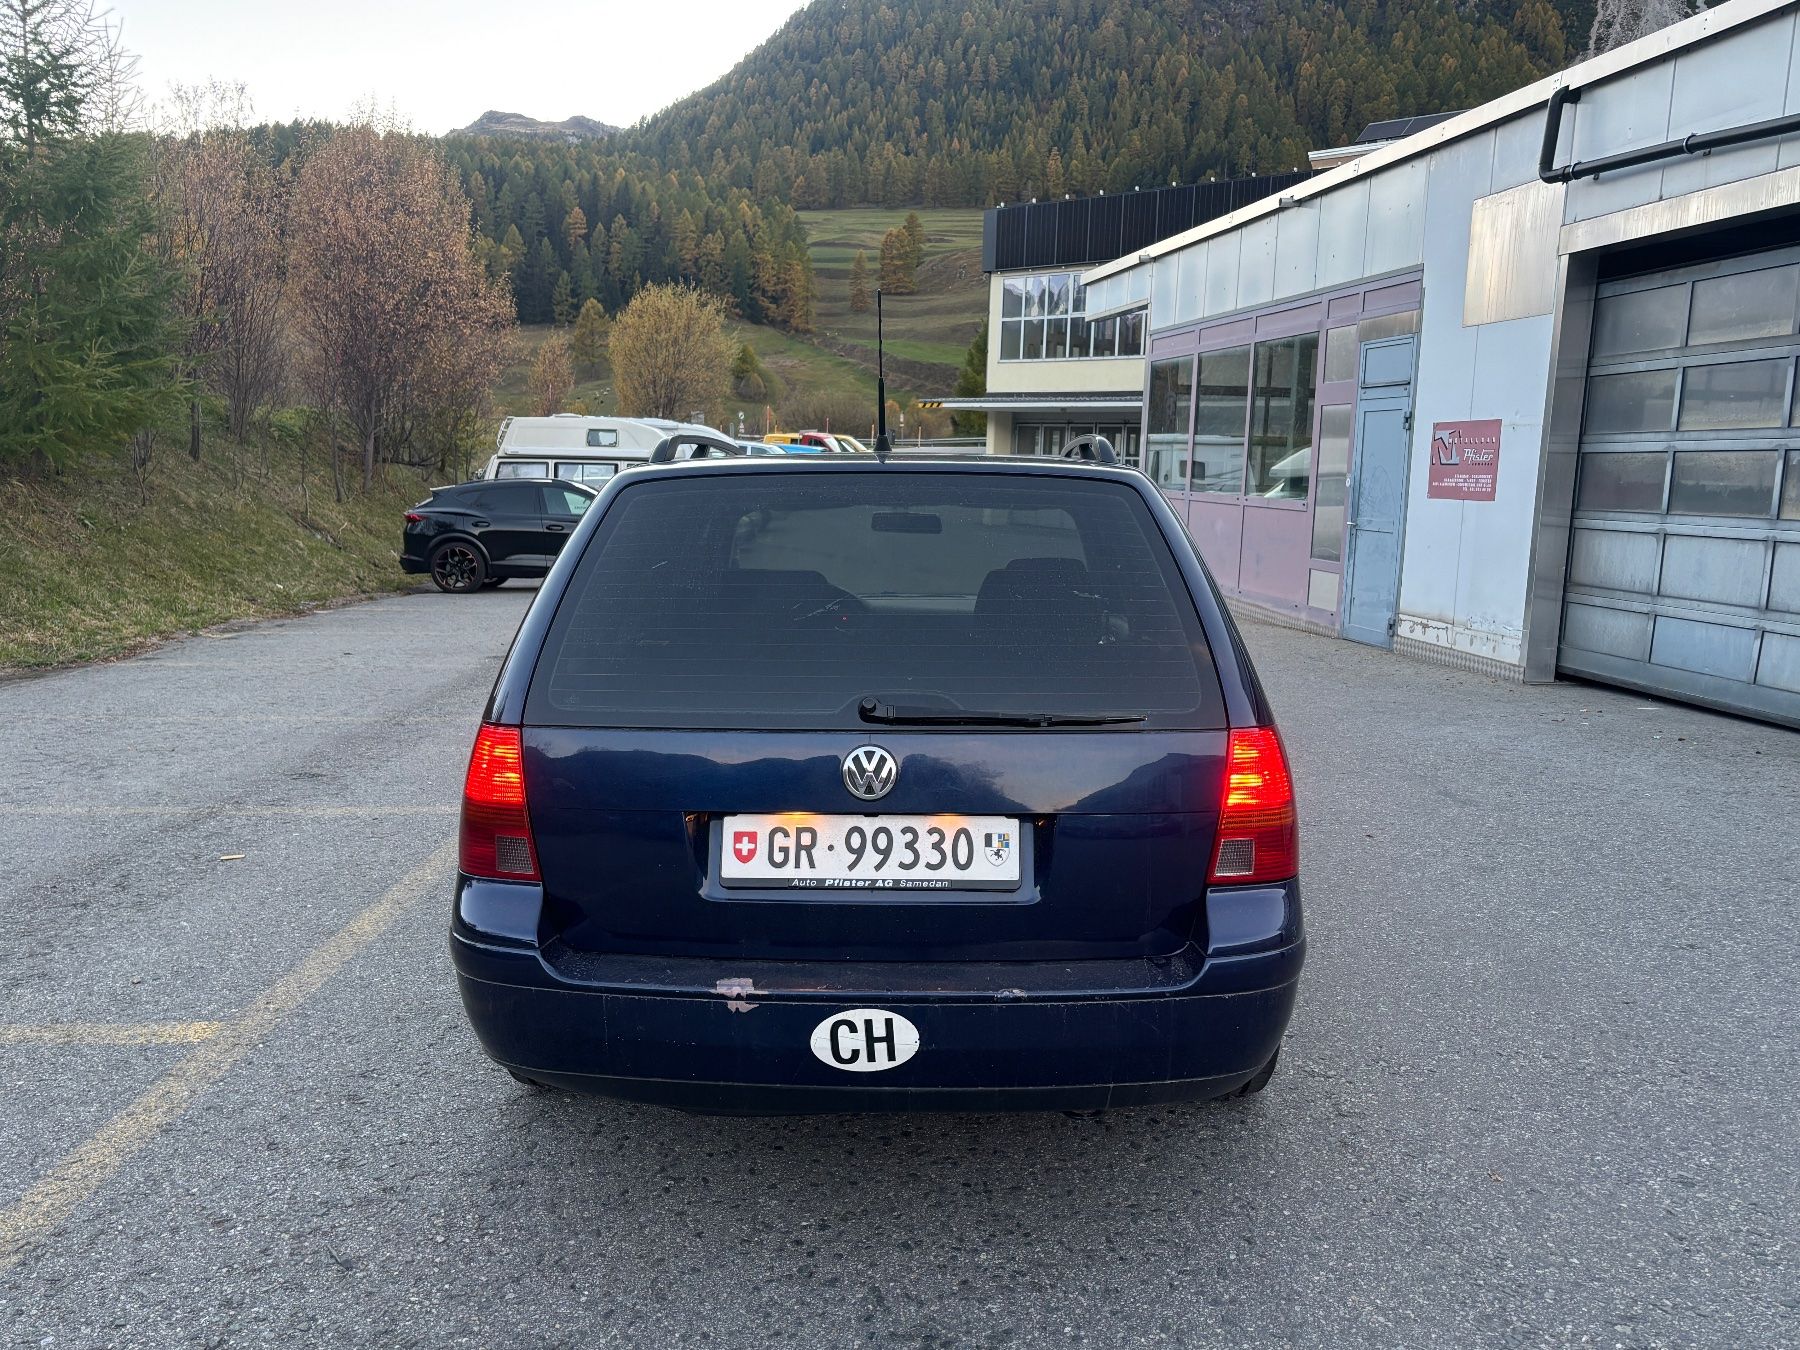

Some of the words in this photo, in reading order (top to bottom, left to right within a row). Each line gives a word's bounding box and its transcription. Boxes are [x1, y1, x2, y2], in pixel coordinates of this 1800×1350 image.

[1463, 448, 1495, 465] Pfister
[792, 878, 817, 887] Auto
[825, 879, 871, 888] Pfister
[875, 879, 894, 888] AG
[899, 879, 949, 888] Samedan
[830, 1017, 897, 1065] CH
